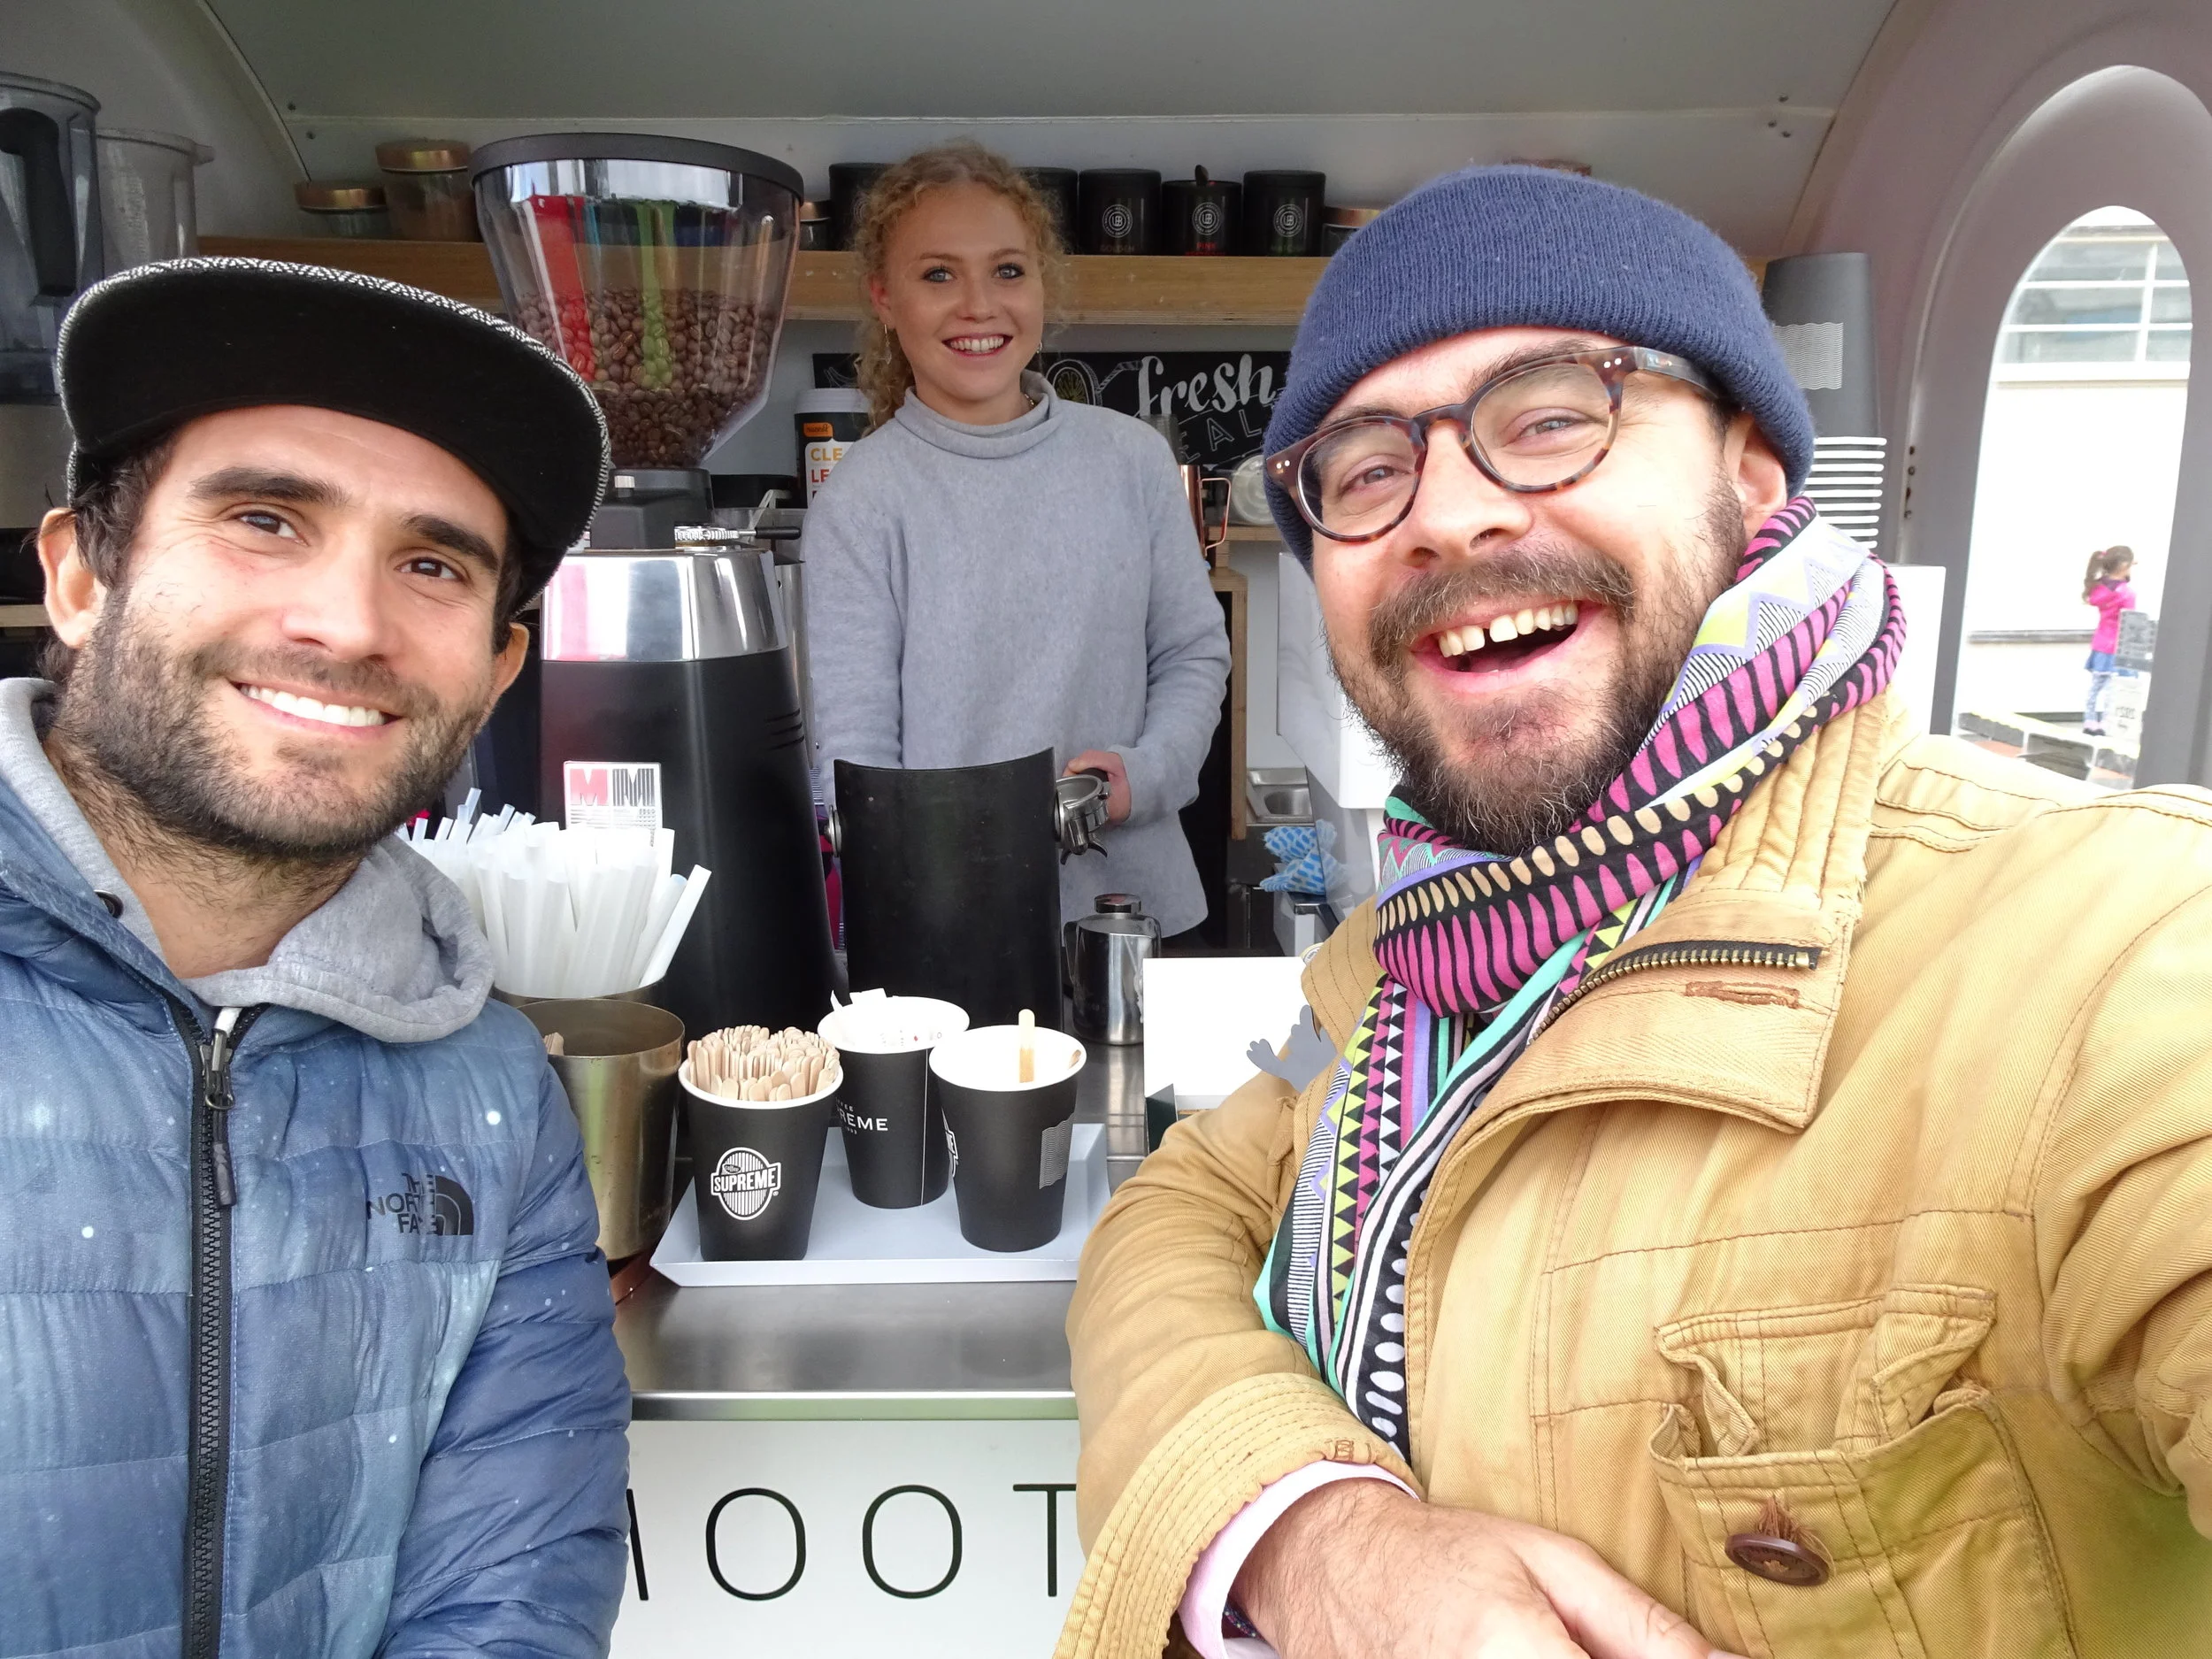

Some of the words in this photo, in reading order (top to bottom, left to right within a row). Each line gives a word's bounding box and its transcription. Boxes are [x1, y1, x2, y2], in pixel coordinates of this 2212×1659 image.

[1135, 353, 1277, 417] fresh
[810, 447, 843, 462] CLE
[713, 1167, 777, 1192] SUPREME
